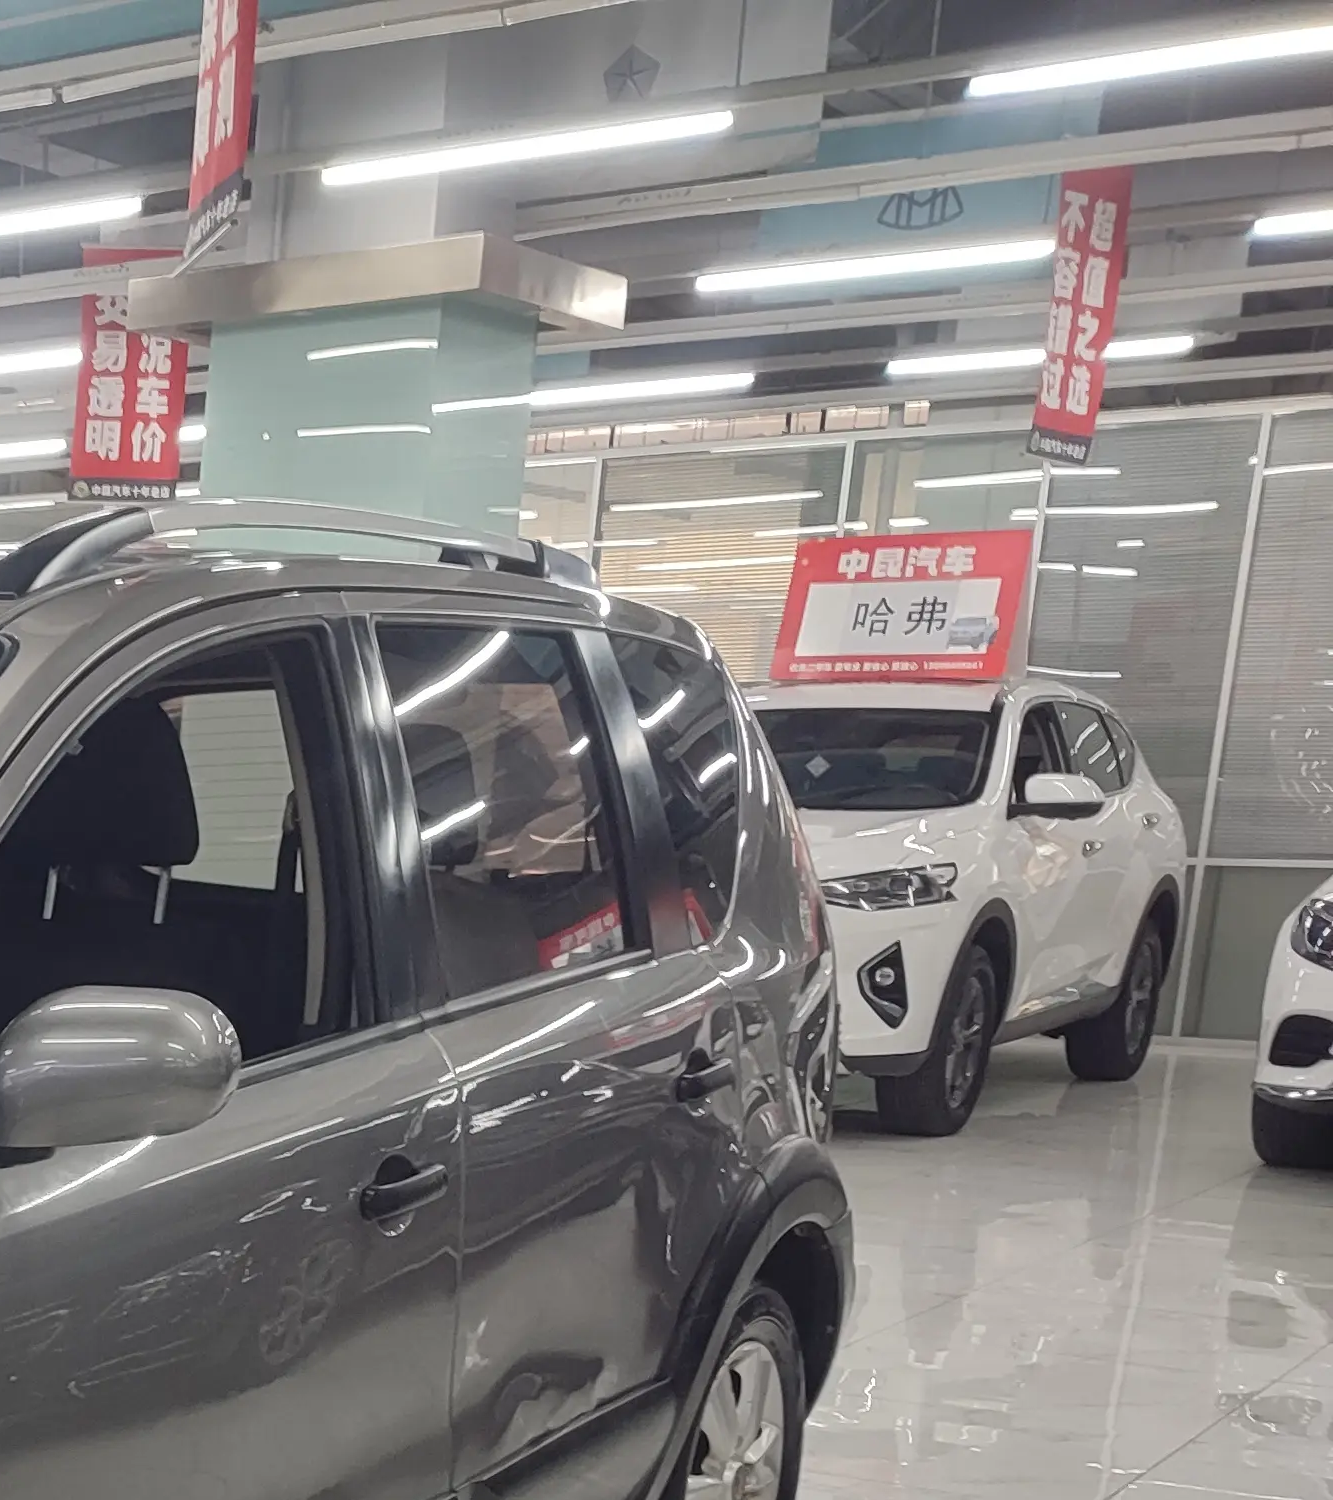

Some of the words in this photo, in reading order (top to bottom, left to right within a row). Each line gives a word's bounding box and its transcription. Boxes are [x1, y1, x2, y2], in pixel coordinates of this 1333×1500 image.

[837, 545, 977, 580] 中昆汽车
[851, 596, 949, 637] 哈弗
